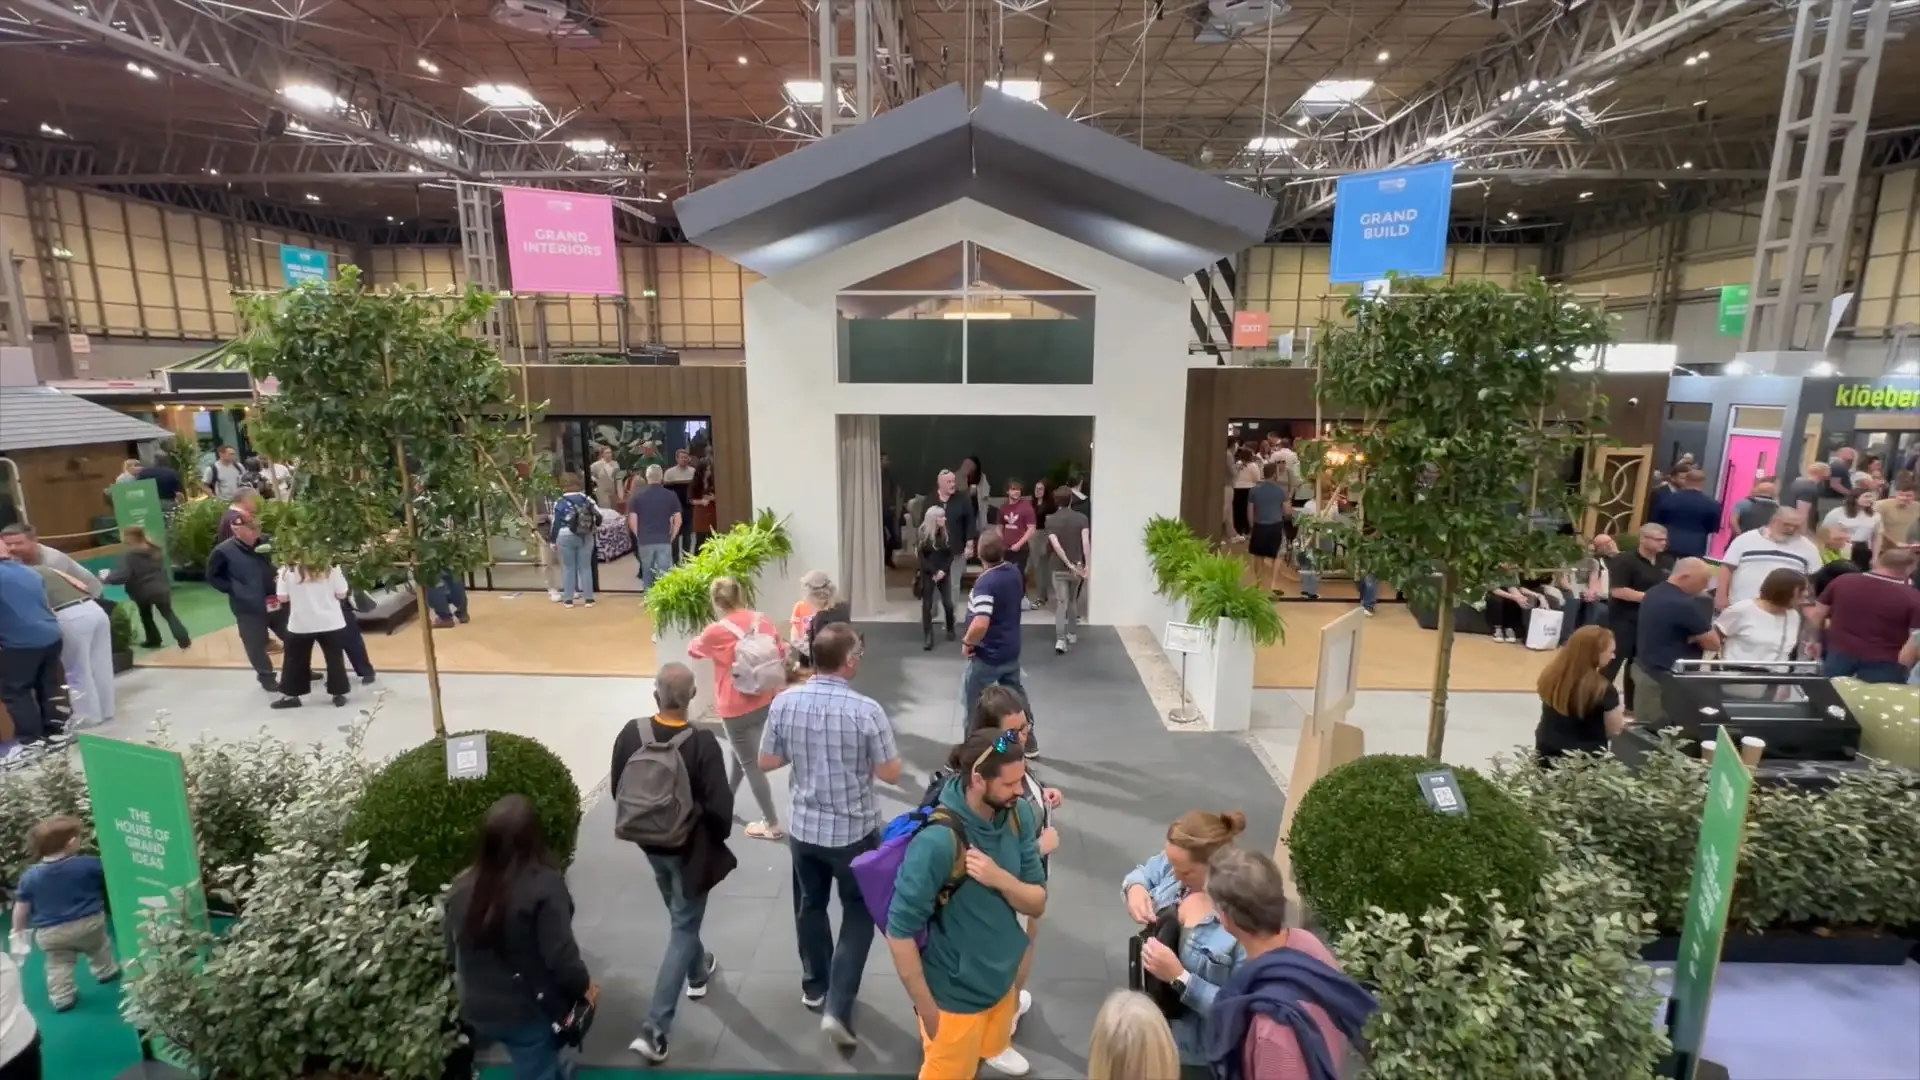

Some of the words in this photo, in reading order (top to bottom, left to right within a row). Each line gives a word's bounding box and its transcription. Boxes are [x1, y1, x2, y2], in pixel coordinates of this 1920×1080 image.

[1360, 208, 1418, 225] GRAND
[534, 228, 588, 244] GRAND
[1363, 224, 1410, 240] BUILD
[522, 241, 602, 256] INTERIORS
[128, 807, 151, 824] THE
[114, 818, 153, 839] HOUSE
[154, 828, 171, 842] OF
[125, 835, 166, 856] GRAND
[132, 851, 165, 871] IDEAS
